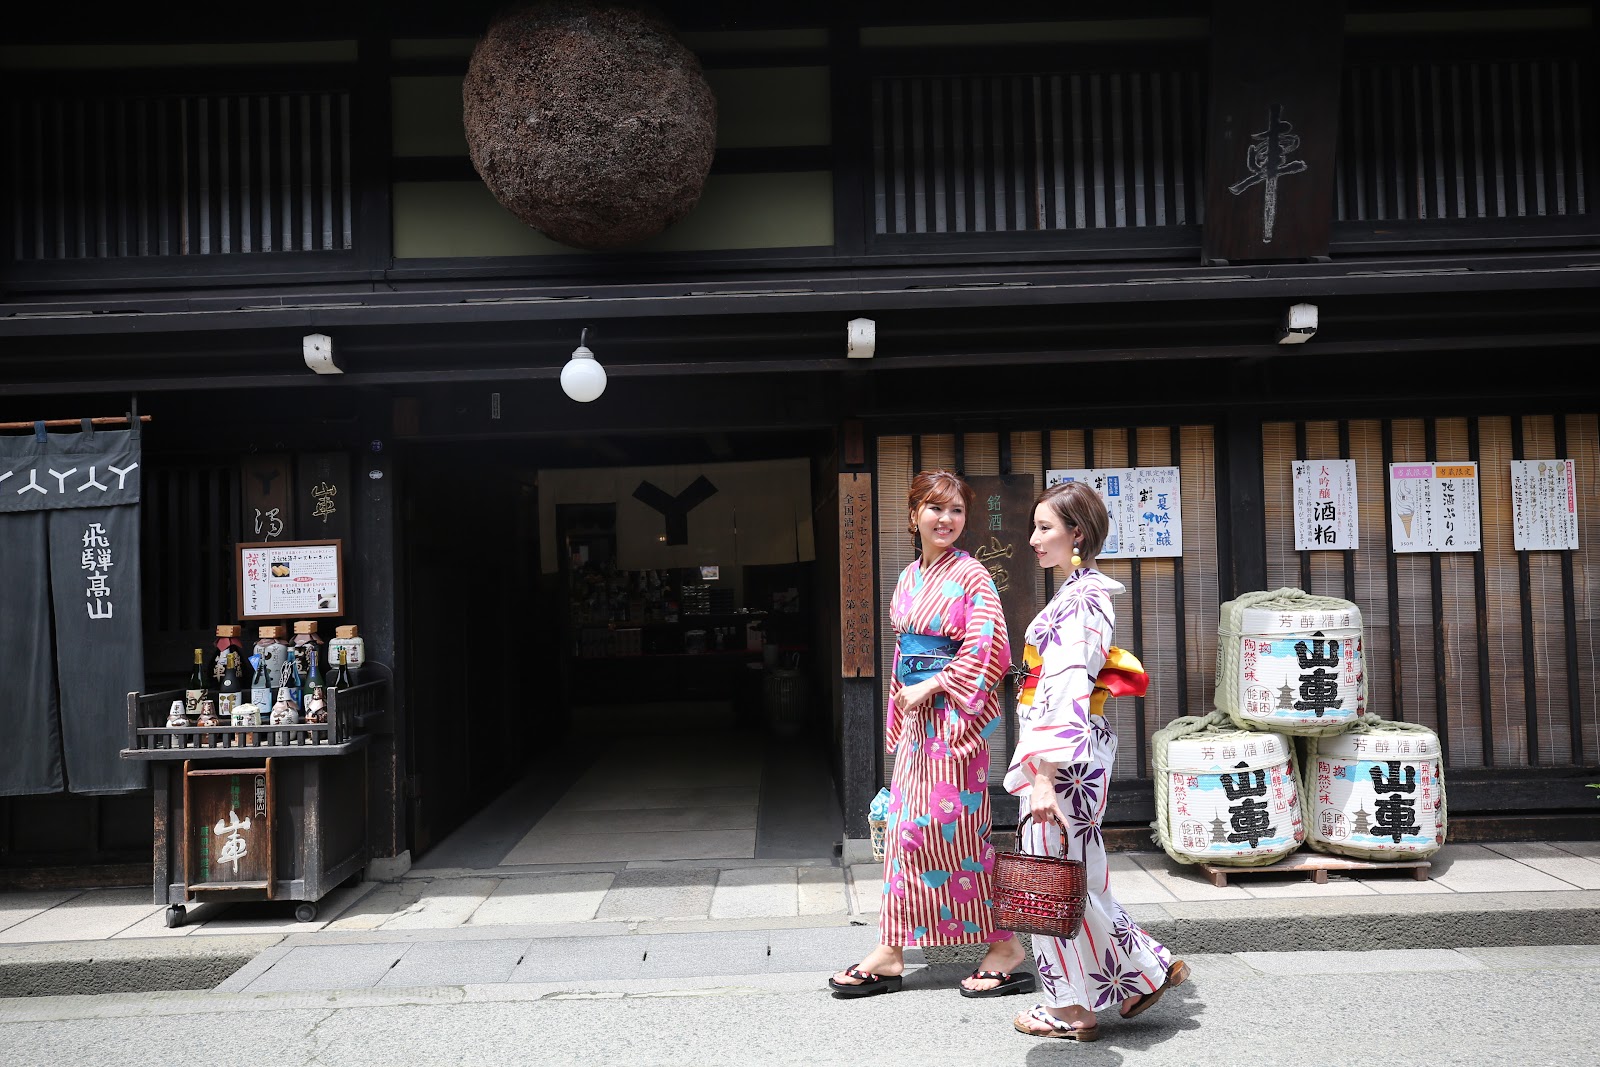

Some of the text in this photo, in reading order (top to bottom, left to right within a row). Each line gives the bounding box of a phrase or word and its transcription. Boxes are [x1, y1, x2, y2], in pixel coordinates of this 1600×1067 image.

[1319, 466, 1331, 499] 大吟醸
[987, 494, 1003, 531] 銘酒
[1155, 493, 1174, 546] 夏吟醸
[1314, 501, 1336, 545] 酒粕
[1442, 479, 1456, 546] 地酒ぷりん
[81, 522, 114, 620] 飛騨高山
[1278, 614, 1350, 628] 芳醇清酒
[253, 690, 267, 706] 夏
[1293, 630, 1344, 718] 山車
[1201, 740, 1275, 761] 芳醇清酒
[1352, 738, 1427, 753] 芳醇清酒
[1219, 761, 1276, 849] 山車
[1369, 760, 1422, 844] 山車
[214, 806, 252, 876] 山車
